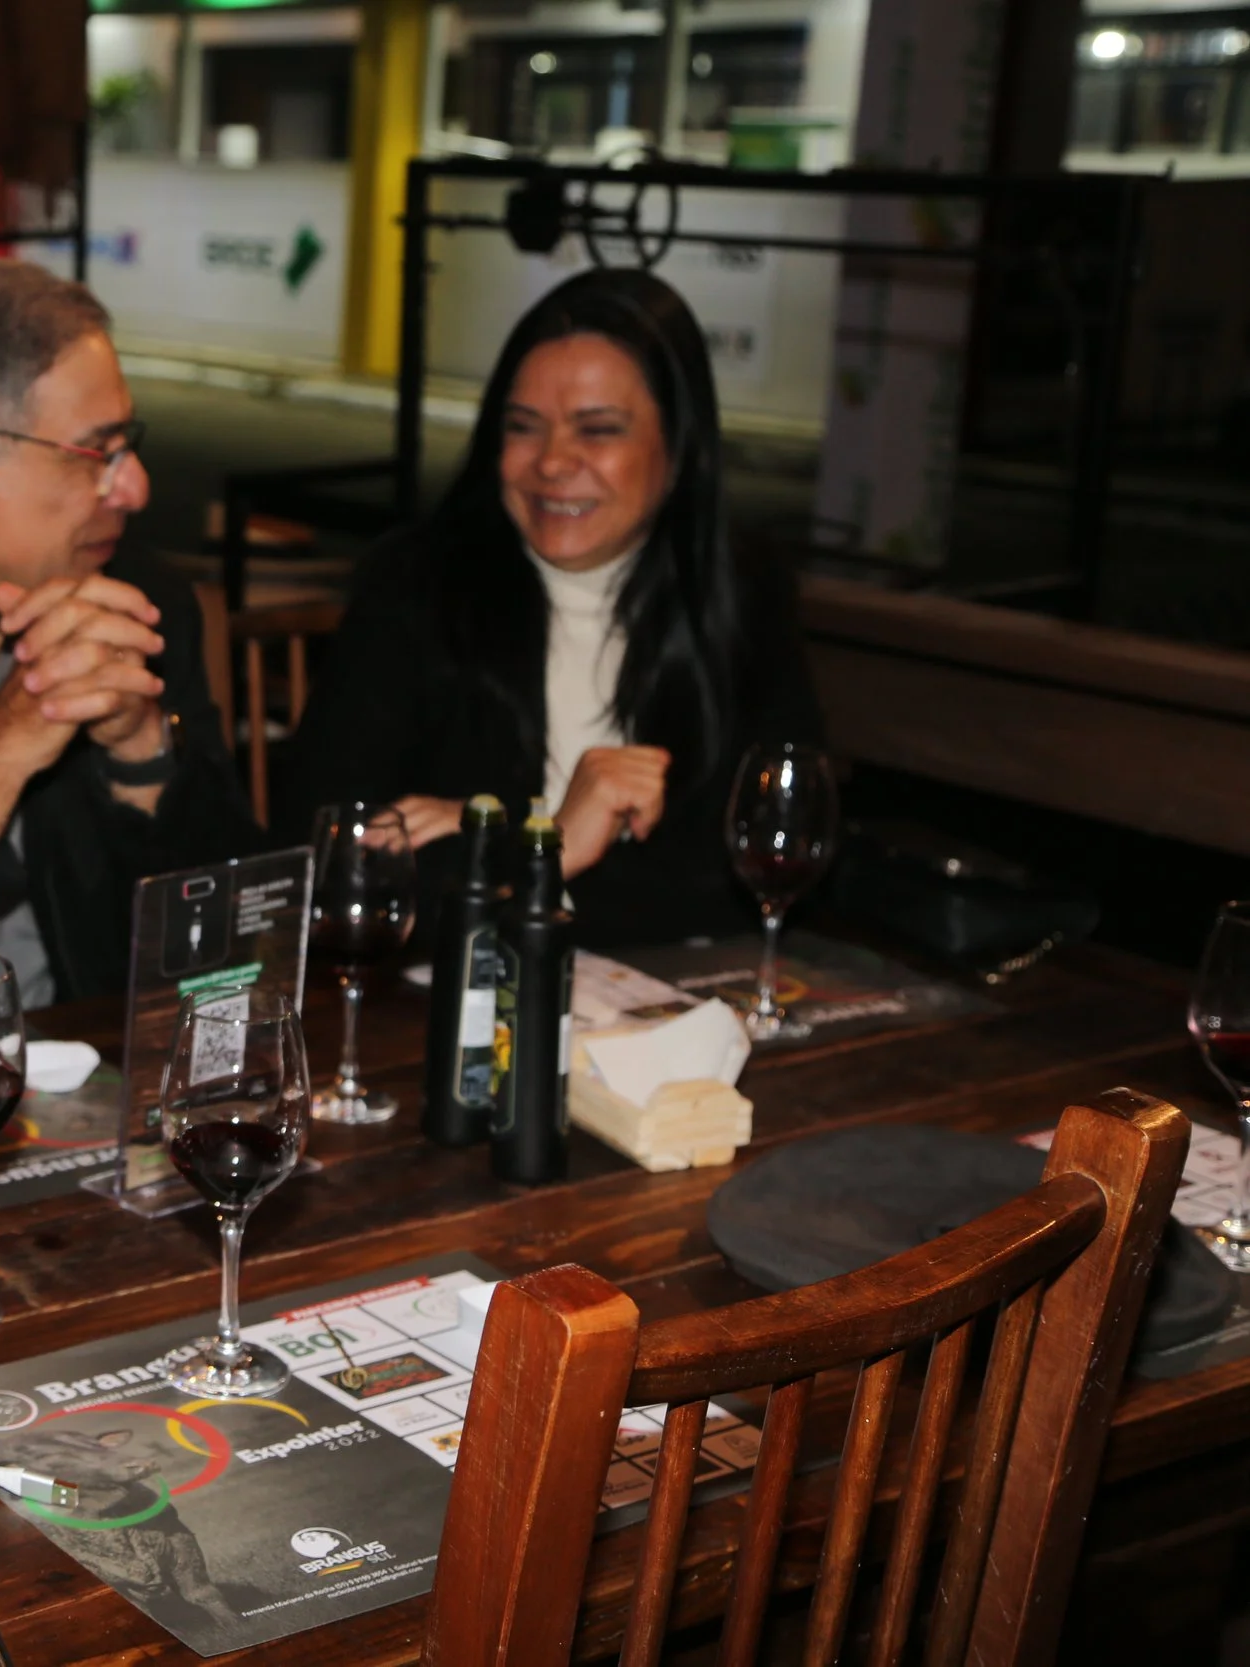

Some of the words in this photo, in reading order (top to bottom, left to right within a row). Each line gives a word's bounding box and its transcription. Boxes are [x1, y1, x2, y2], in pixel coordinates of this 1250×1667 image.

[278, 1328, 358, 1358] BOI
[235, 1420, 364, 1464] Expointer
[324, 1429, 381, 1451] 2022
[299, 1540, 386, 1574] BRANGUS
[366, 1551, 396, 1564] SUL
